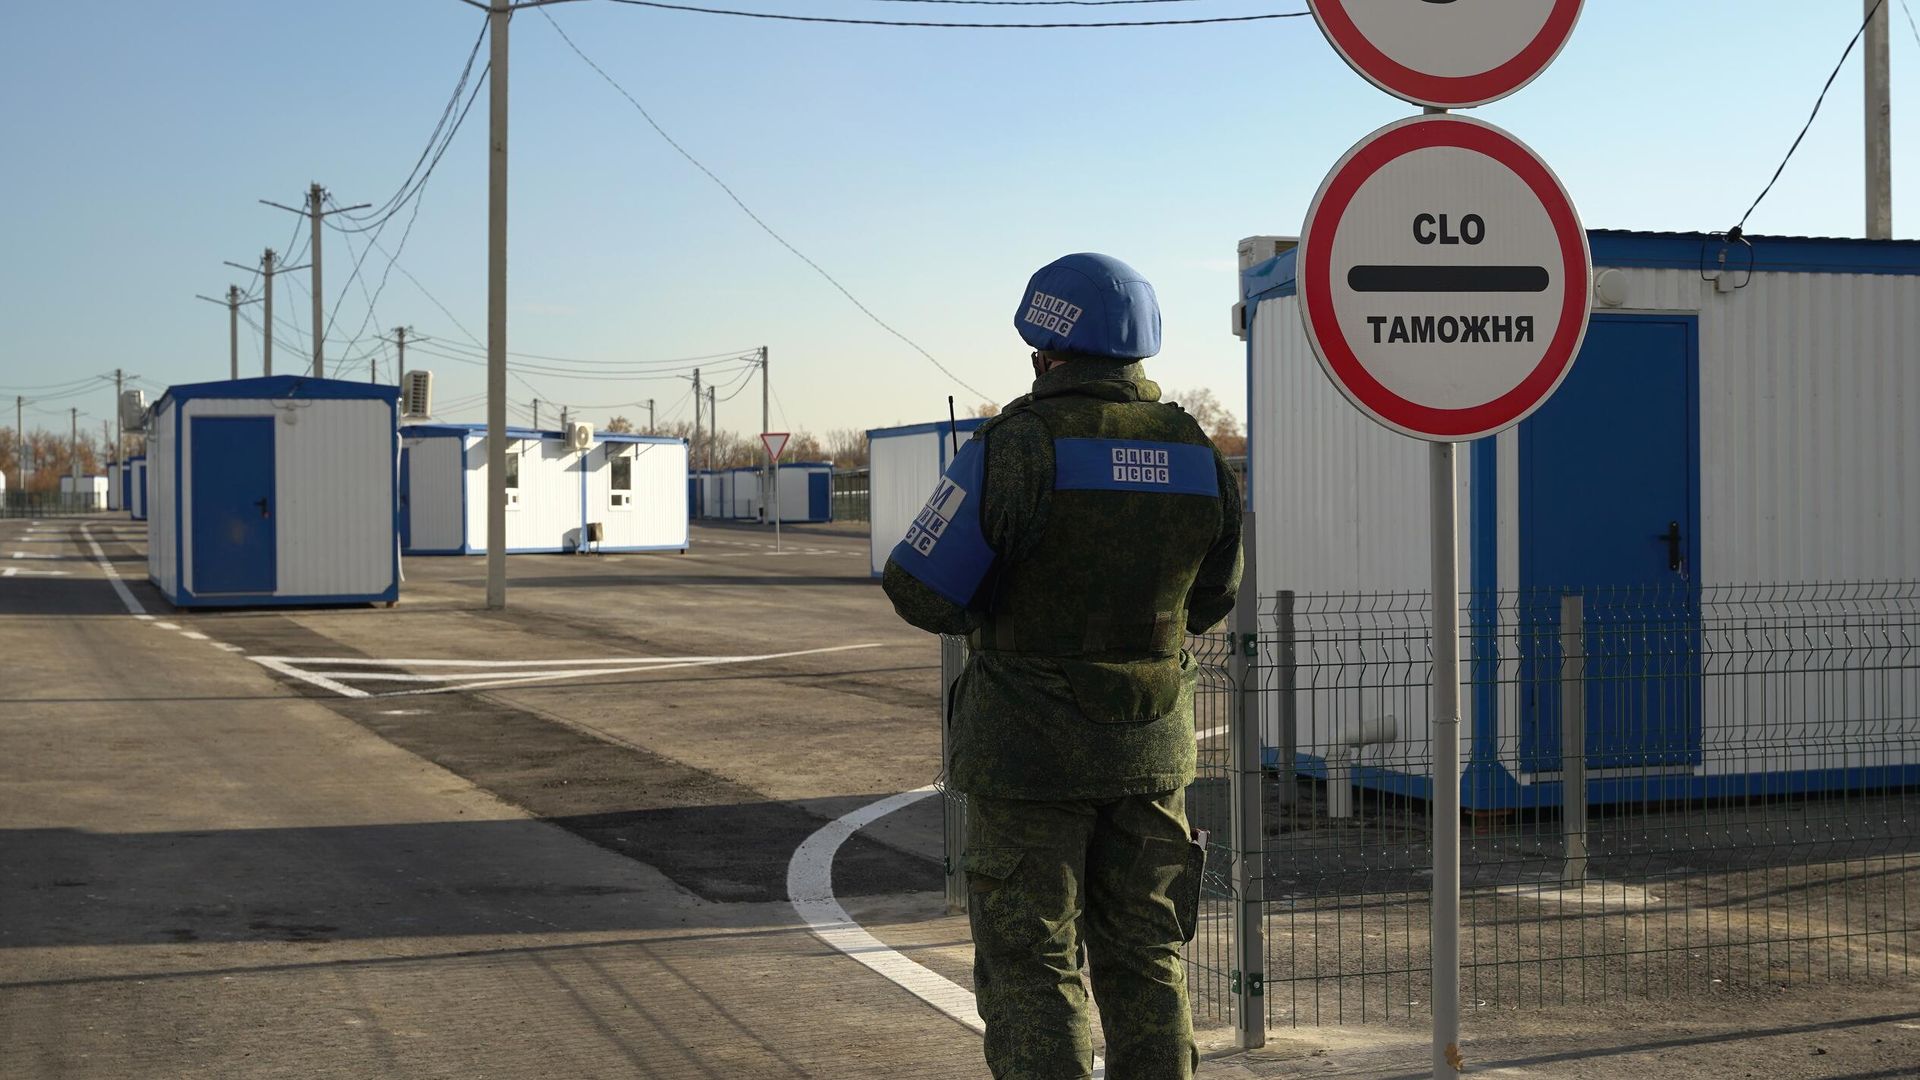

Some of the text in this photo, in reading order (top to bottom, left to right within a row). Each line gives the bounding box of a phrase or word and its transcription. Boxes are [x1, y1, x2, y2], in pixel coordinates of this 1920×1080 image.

[1412, 213, 1486, 245] CLO
[1366, 315, 1535, 344] ТАМОЖНЯ
[1115, 449, 1165, 465] СЦКК
